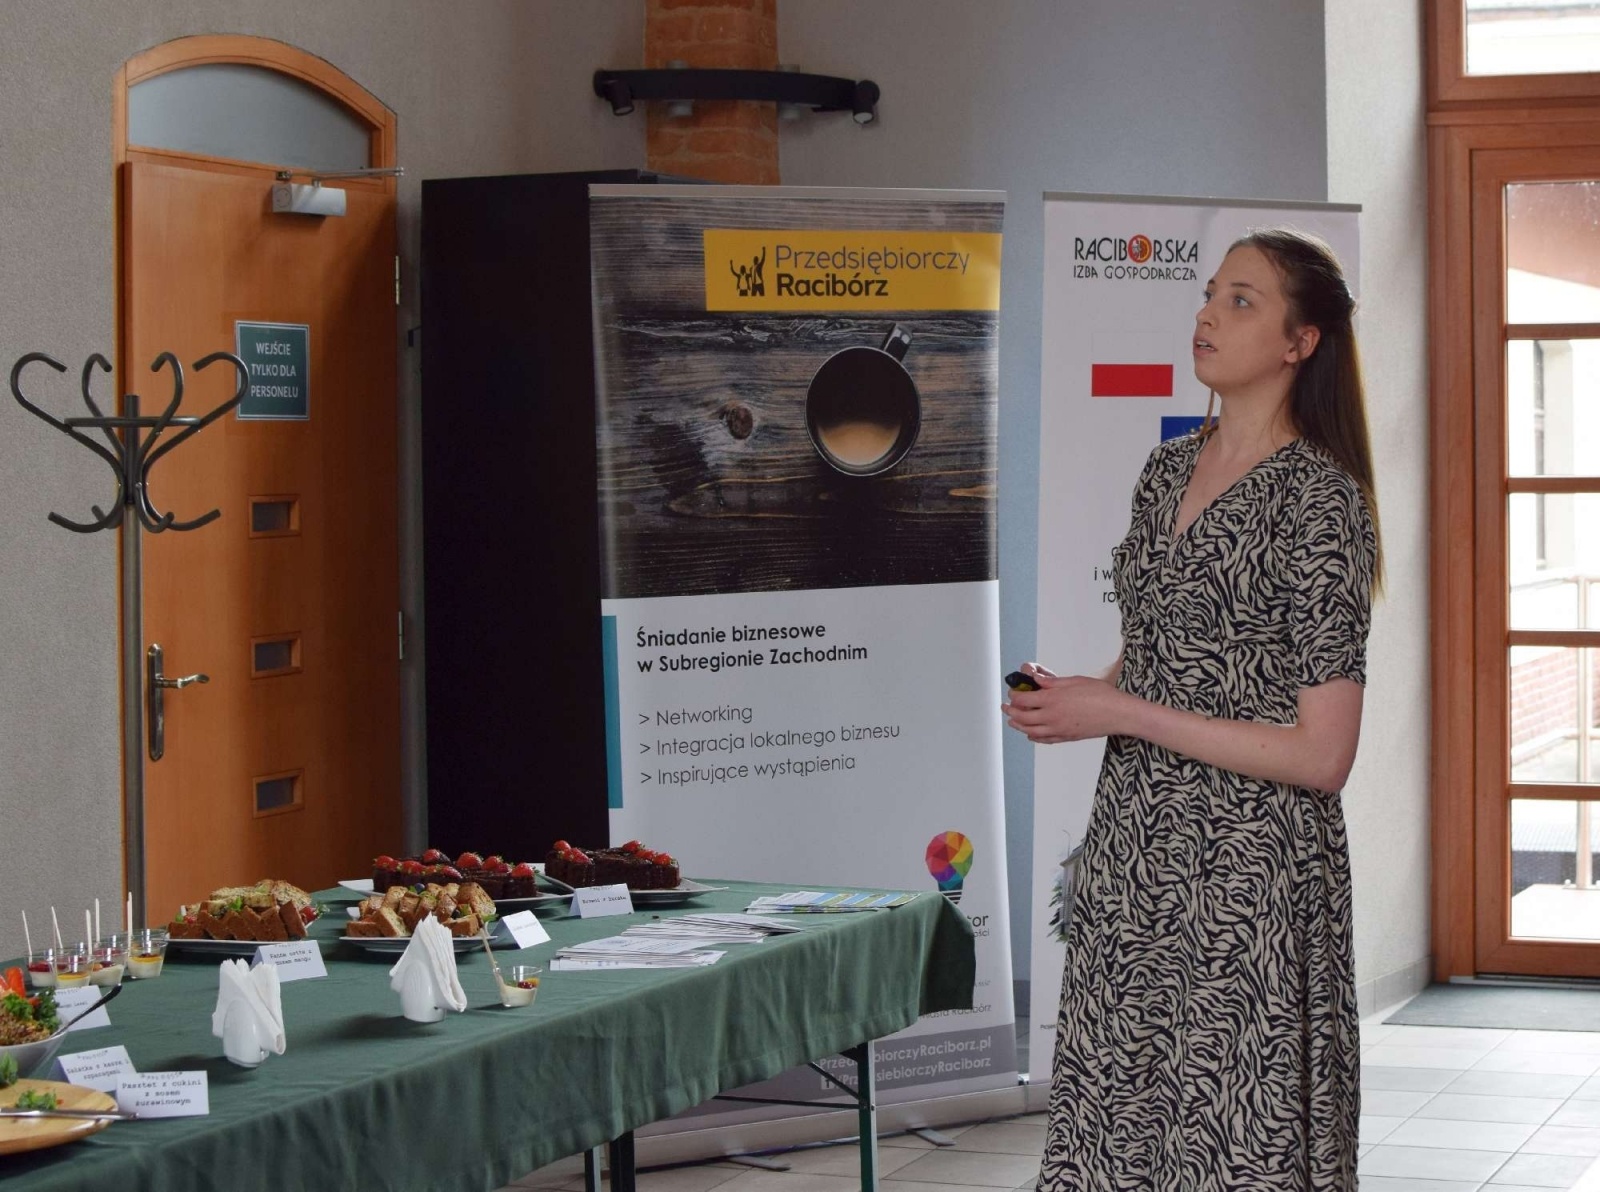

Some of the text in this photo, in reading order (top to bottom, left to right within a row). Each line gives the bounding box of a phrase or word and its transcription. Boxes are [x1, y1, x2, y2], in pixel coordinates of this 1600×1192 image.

[775, 245, 970, 275] Przedsiębiorczy
[1073, 265, 1197, 280] IZBA GOSPODARCZA
[776, 272, 889, 296] Racibórz
[255, 340, 291, 356] WEJŚCIE
[251, 363, 297, 377] TYLKO DLA
[250, 385, 299, 398] PERSONELU
[1102, 591, 1117, 603] ro
[636, 625, 826, 648] Śniadanie biznesowe
[637, 644, 868, 672] w Subregionie Zachodnim
[656, 704, 753, 726] Networking
[657, 724, 901, 757] Integracja lokalnego biznesu
[657, 755, 856, 787] Inspirujące wystąpienia
[172, 1079, 202, 1087] cukini
